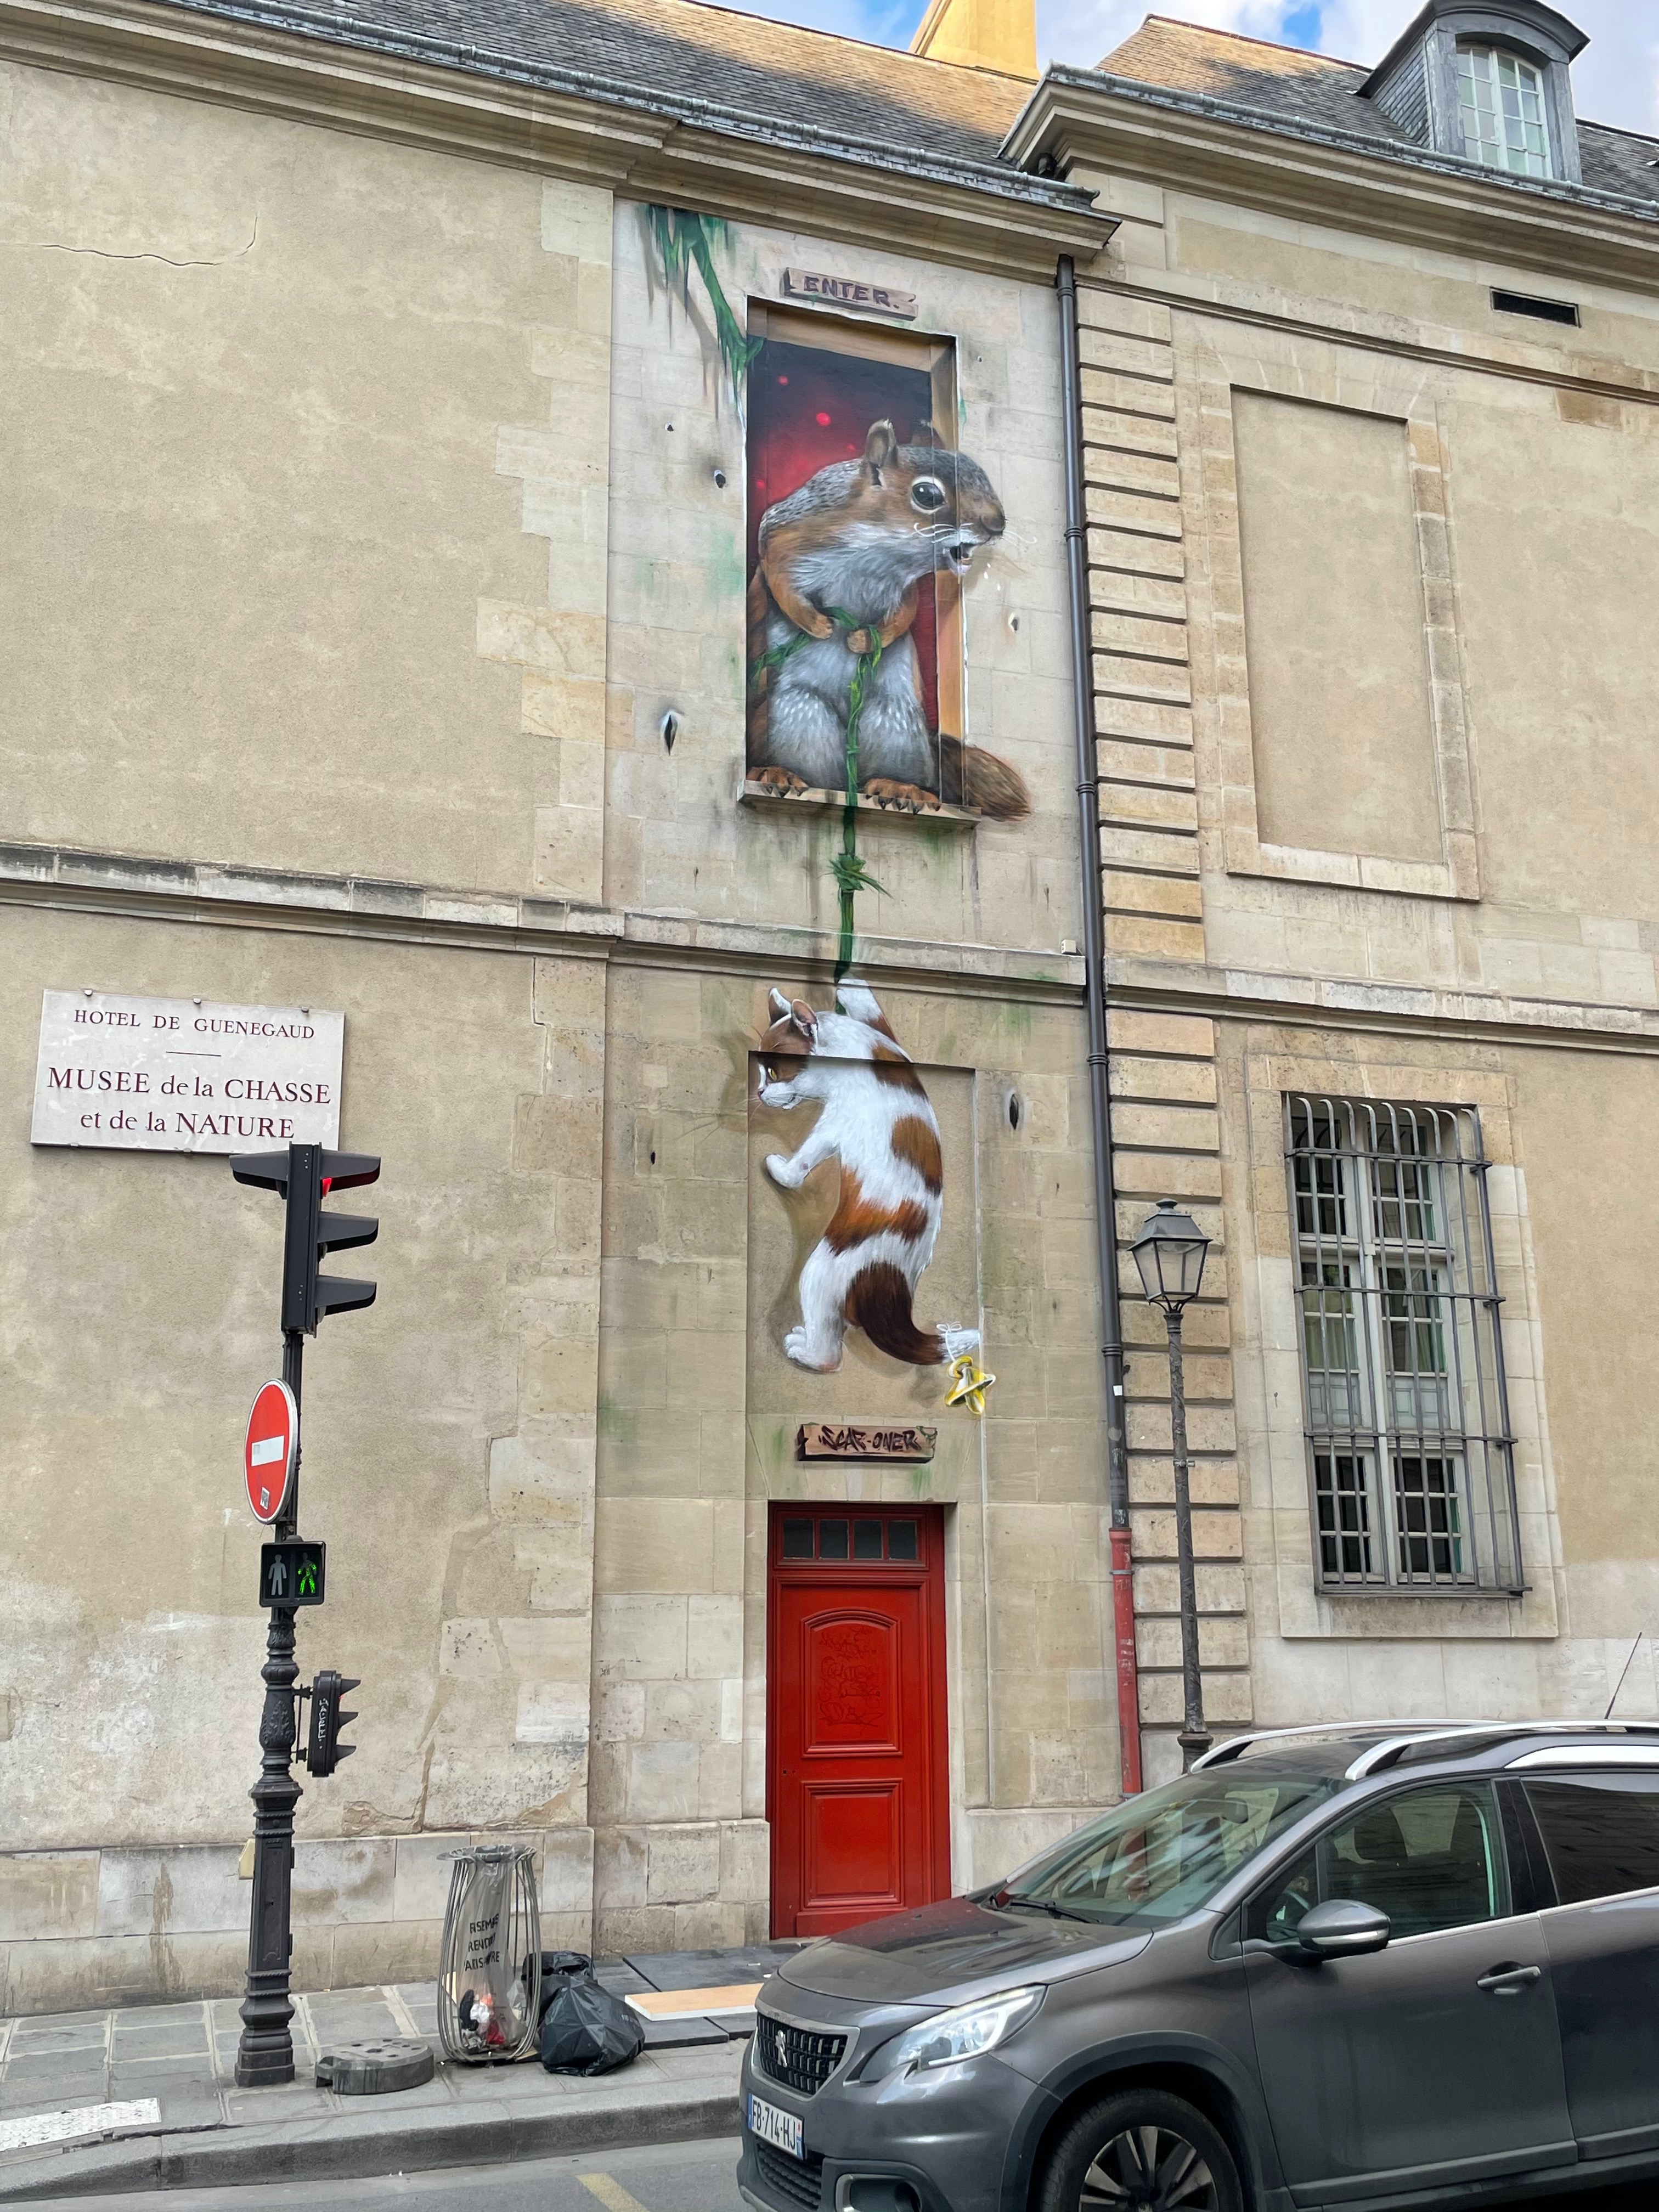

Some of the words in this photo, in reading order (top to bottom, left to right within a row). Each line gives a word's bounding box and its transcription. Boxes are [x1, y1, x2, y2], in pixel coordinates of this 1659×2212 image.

[74, 1009, 141, 1027] HOTEL
[152, 1015, 180, 1030] DE
[194, 1018, 315, 1040] GUENEGAUD
[47, 1067, 150, 1093] MUSEE
[161, 1075, 189, 1096] de
[193, 1077, 215, 1097] la
[224, 1079, 332, 1104] CHASSE
[80, 1111, 102, 1129] et
[109, 1110, 138, 1131] de
[146, 1112, 166, 1132] la
[175, 1112, 296, 1139] NATURE
